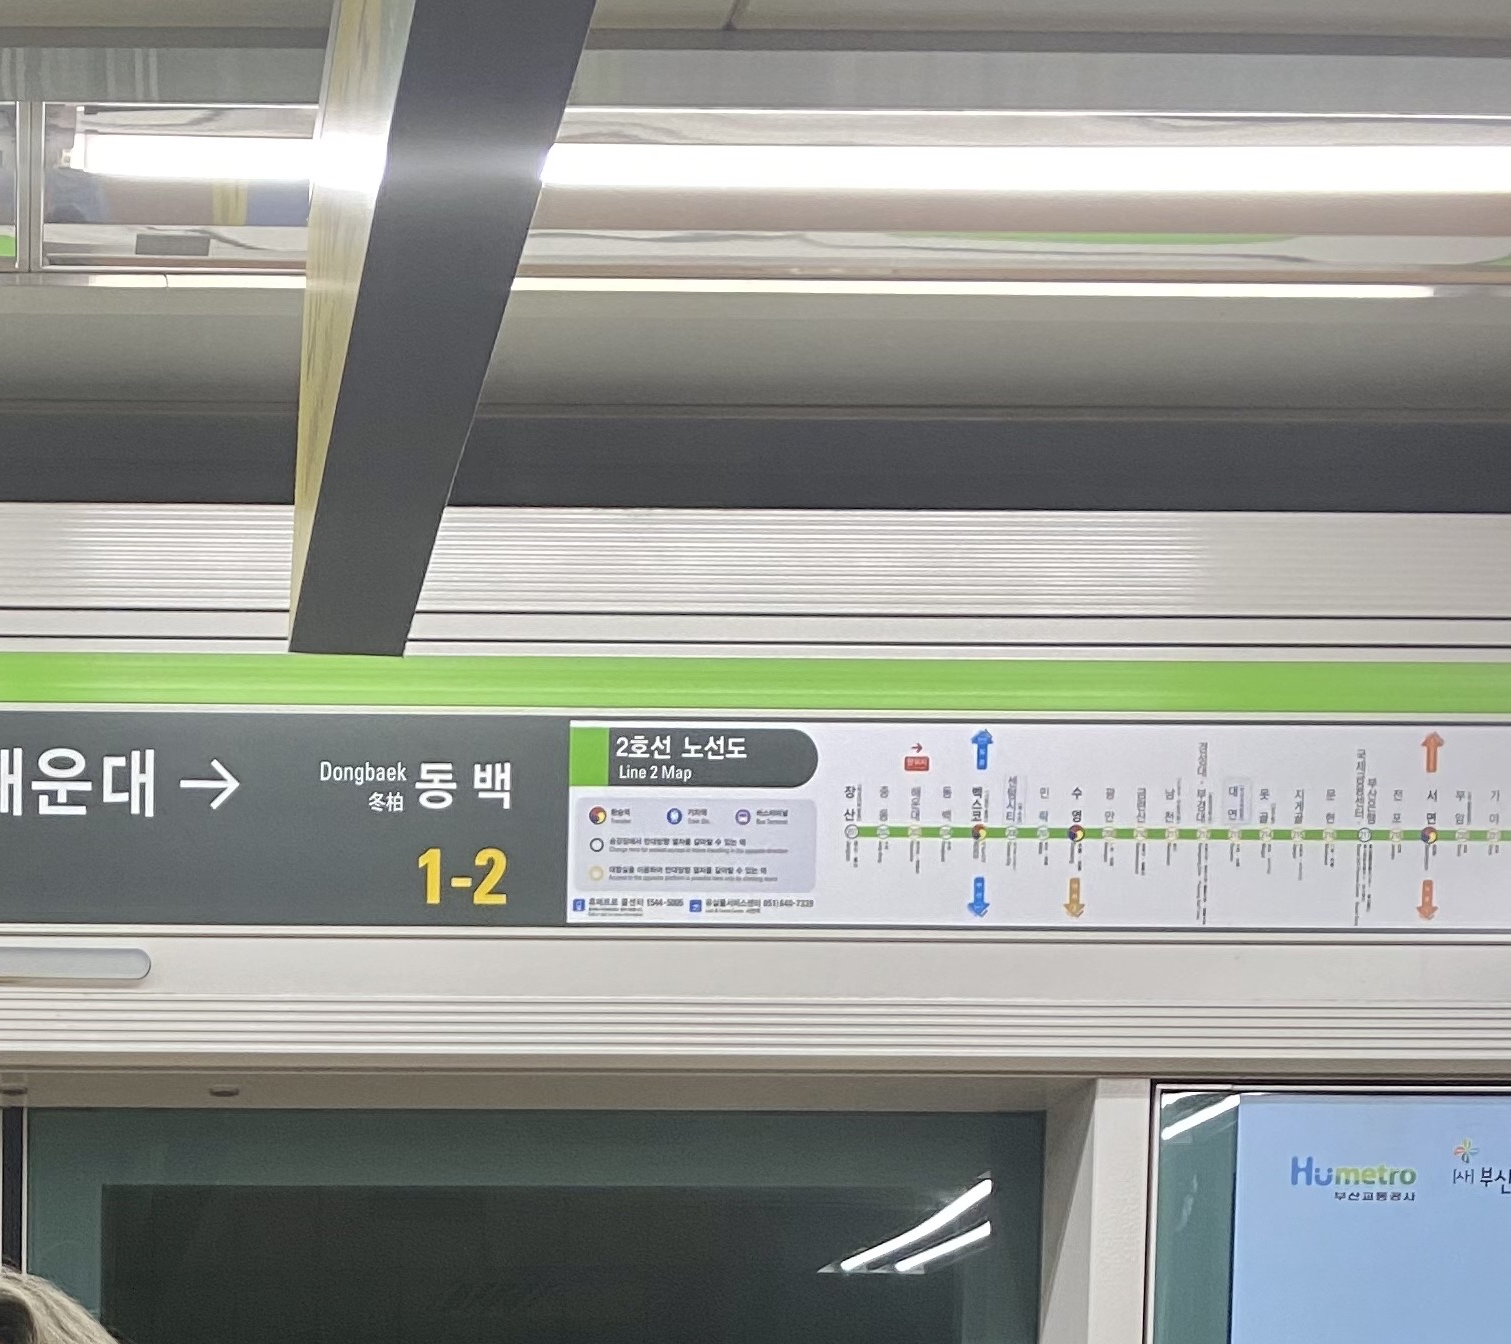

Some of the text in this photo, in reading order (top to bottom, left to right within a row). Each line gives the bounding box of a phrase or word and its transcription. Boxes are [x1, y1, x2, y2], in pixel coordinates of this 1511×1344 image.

[616, 736, 747, 760] 2호선 노선도
[320, 760, 407, 785] Dongbaek
[619, 765, 692, 783] Line 2 Map
[368, 791, 405, 813] 冬柏
[416, 848, 509, 907] 1-2
[1291, 1156, 1417, 1186] Humetro
